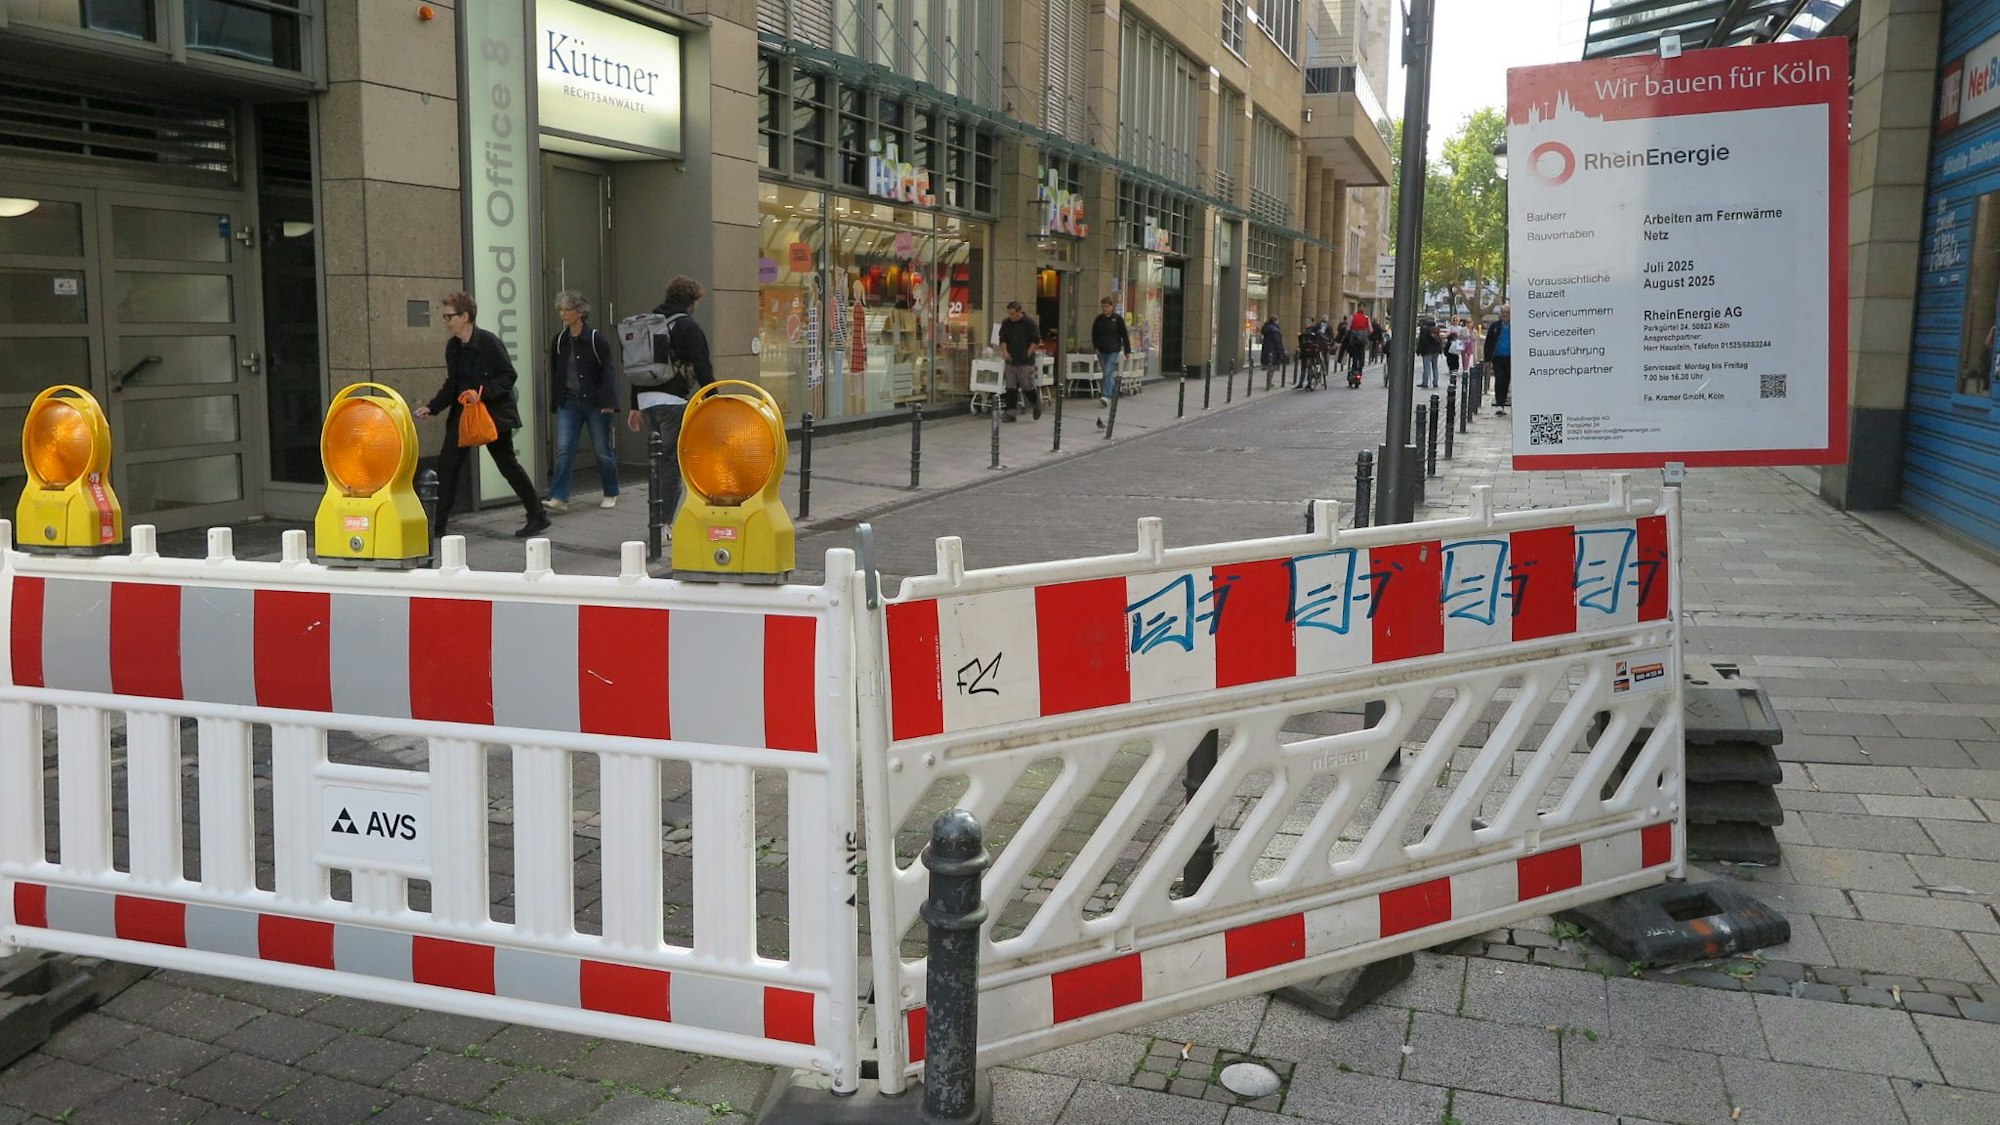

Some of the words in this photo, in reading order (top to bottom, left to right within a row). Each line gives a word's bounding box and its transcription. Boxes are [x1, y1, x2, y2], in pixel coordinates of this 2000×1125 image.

[483, 38, 510, 66] 8
[546, 30, 659, 97] Küttner
[1593, 79, 1639, 101] Wir
[1645, 74, 1723, 97] bauen
[1729, 67, 1767, 90] für
[1773, 61, 1831, 86] Köln
[1968, 55, 2000, 100] NetB
[563, 85, 646, 114] RECHTSANWÄLTE
[486, 82, 515, 229] Office
[1584, 144, 1730, 171] RheinEnergie
[1527, 210, 1567, 223] Bauherr
[1643, 211, 1693, 226] Arbeiten
[1695, 213, 1714, 223] am
[1717, 207, 1783, 222] Fernwärme
[1527, 229, 1595, 242] Bauvorhaben
[1643, 229, 1669, 241] Netz
[1643, 261, 1664, 274] Juli
[1667, 260, 1694, 272] 2025
[1527, 273, 1611, 287] Voraussichtliche
[1643, 276, 1685, 291] August
[1688, 275, 1715, 288] 2025
[1528, 289, 1566, 300] Bauzeit
[1528, 306, 1614, 319] Servicenummern
[1643, 308, 1722, 323] RheinEnergie
[1724, 306, 1743, 319] AG
[1528, 326, 1596, 339] Servicezeiten
[1643, 324, 1679, 333] Parkgürtel
[1529, 345, 1606, 359] Bauausführung
[1643, 344, 1658, 352] Herr
[1693, 342, 1719, 350] Telefon
[1529, 364, 1614, 378] Ansprechpartner
[1684, 362, 1710, 371] Montag
[1724, 361, 1748, 370] Freitag
[1656, 393, 1681, 401] Kramer
[1708, 392, 1725, 400] Köln
[366, 810, 417, 841] AVS
